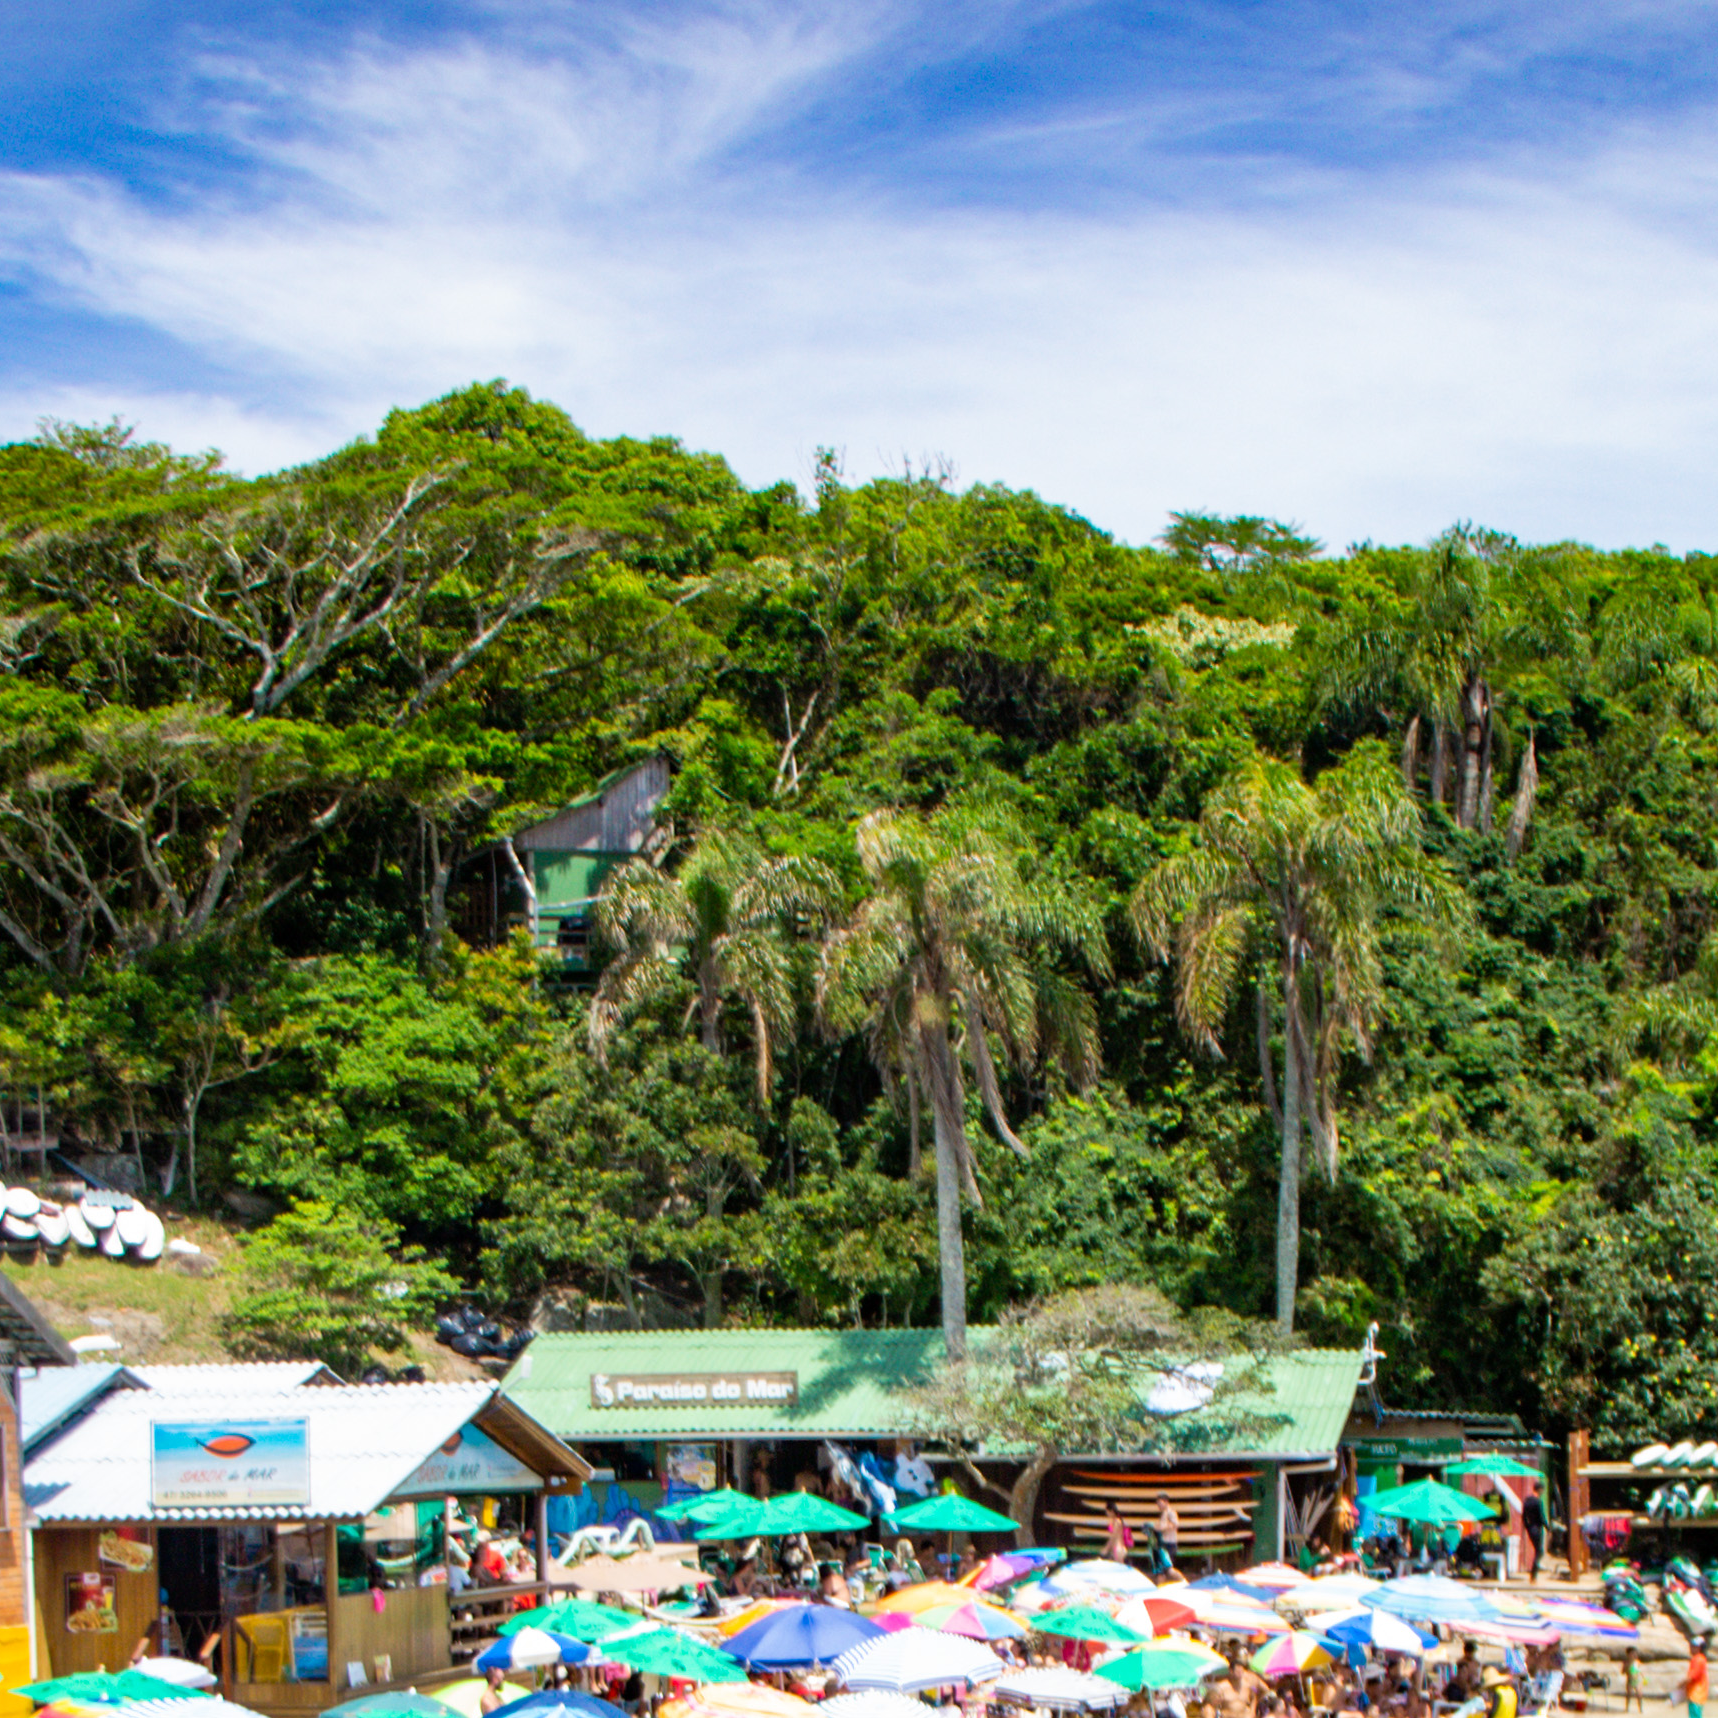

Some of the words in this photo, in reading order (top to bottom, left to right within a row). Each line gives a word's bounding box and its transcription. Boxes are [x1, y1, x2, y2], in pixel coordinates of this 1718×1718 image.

[712, 1380, 741, 1400] do
[747, 1379, 794, 1399] Mar
[180, 1469, 228, 1483] SABOR
[243, 1467, 278, 1481] MAR
